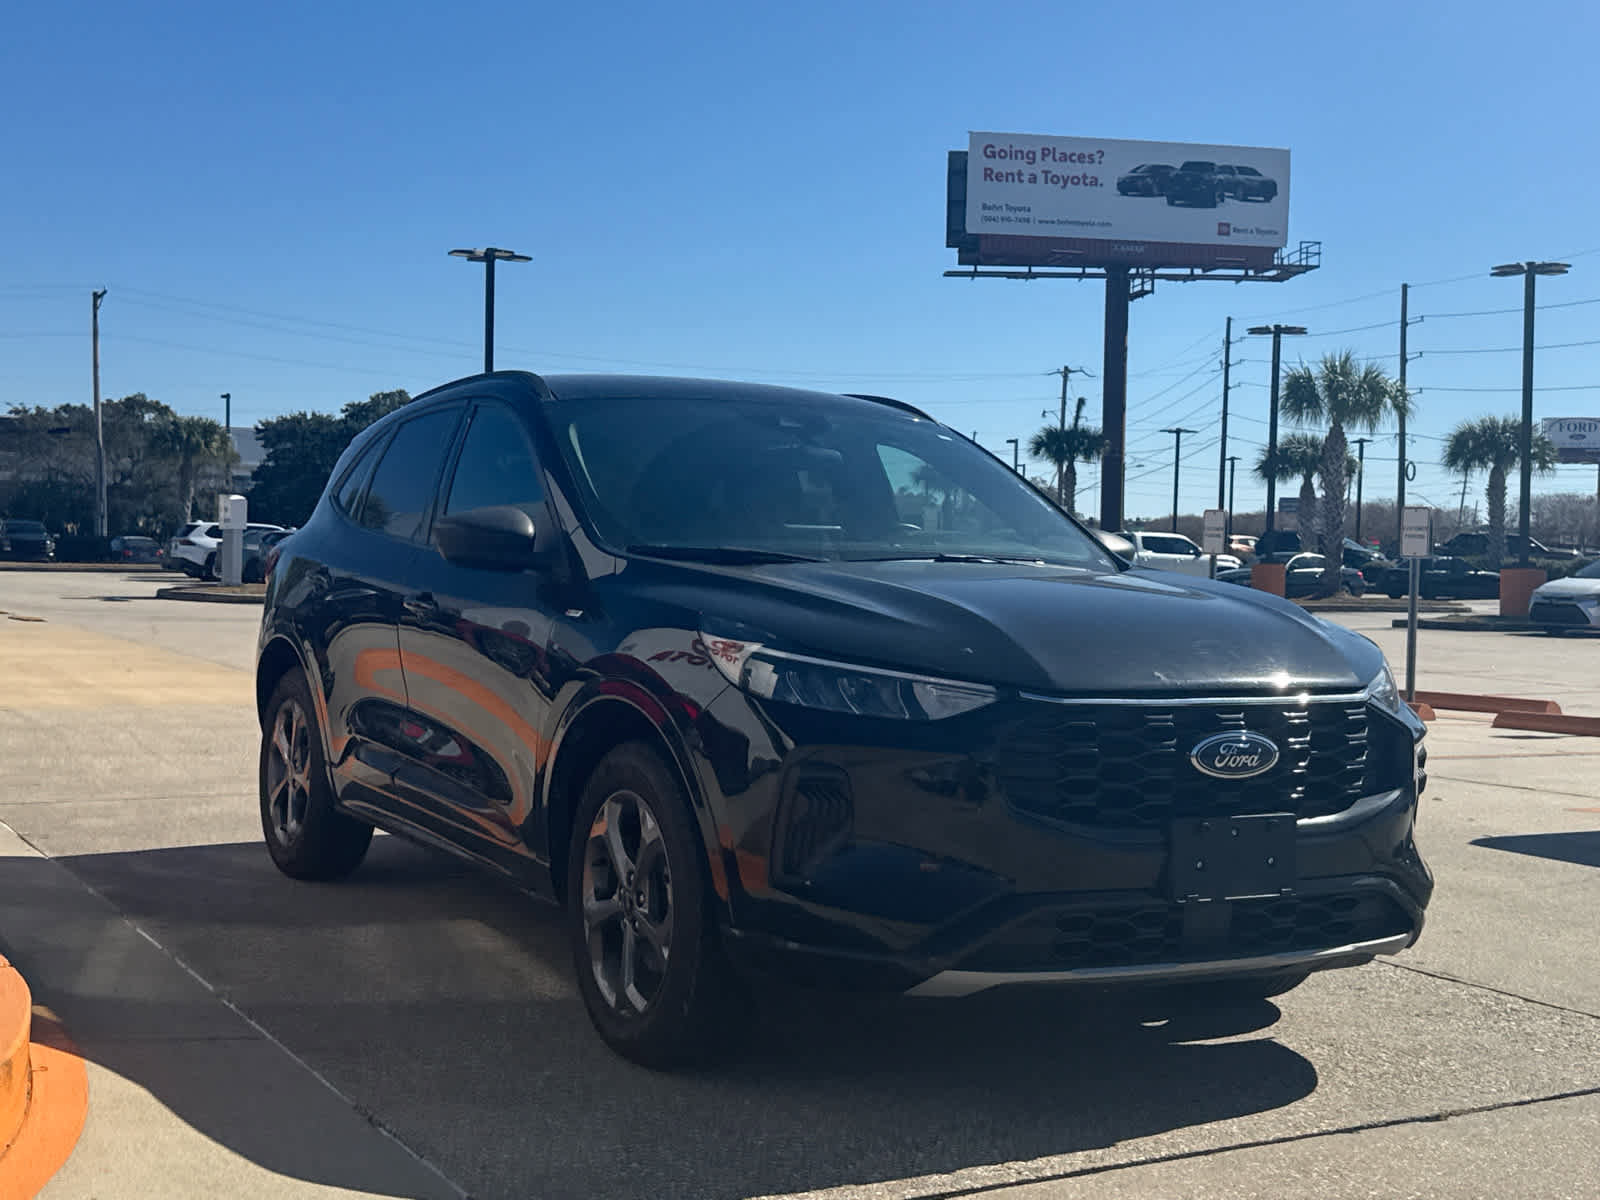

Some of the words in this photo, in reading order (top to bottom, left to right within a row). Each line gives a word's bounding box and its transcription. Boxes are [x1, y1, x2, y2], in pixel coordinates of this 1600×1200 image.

[983, 144, 1037, 165] Going
[1040, 146, 1105, 165] Places?
[983, 167, 1025, 184] Rent
[1027, 173, 1038, 185] a
[1040, 169, 1104, 190] Toyota.
[1559, 422, 1598, 433] FORD
[1213, 742, 1263, 768] Ford
